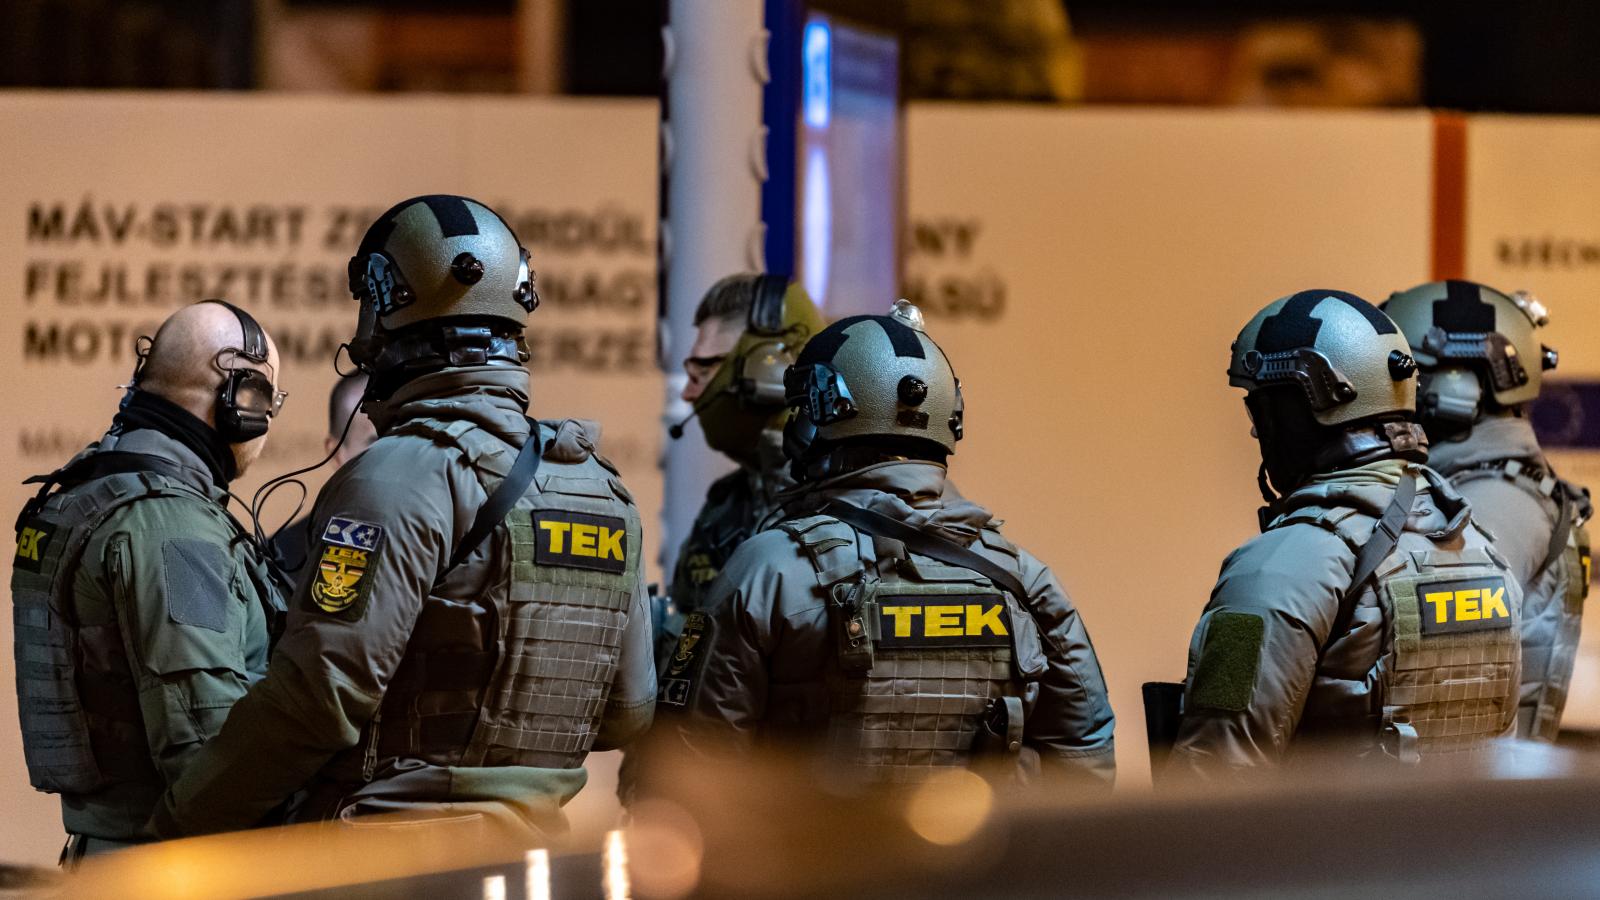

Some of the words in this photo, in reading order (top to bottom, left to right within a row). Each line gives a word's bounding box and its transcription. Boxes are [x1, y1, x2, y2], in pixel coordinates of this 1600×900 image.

[17, 527, 47, 561] EK
[326, 546, 368, 561] TEK
[540, 520, 625, 561] TEK
[882, 604, 1009, 638] TEK
[1425, 587, 1509, 624] TEK
